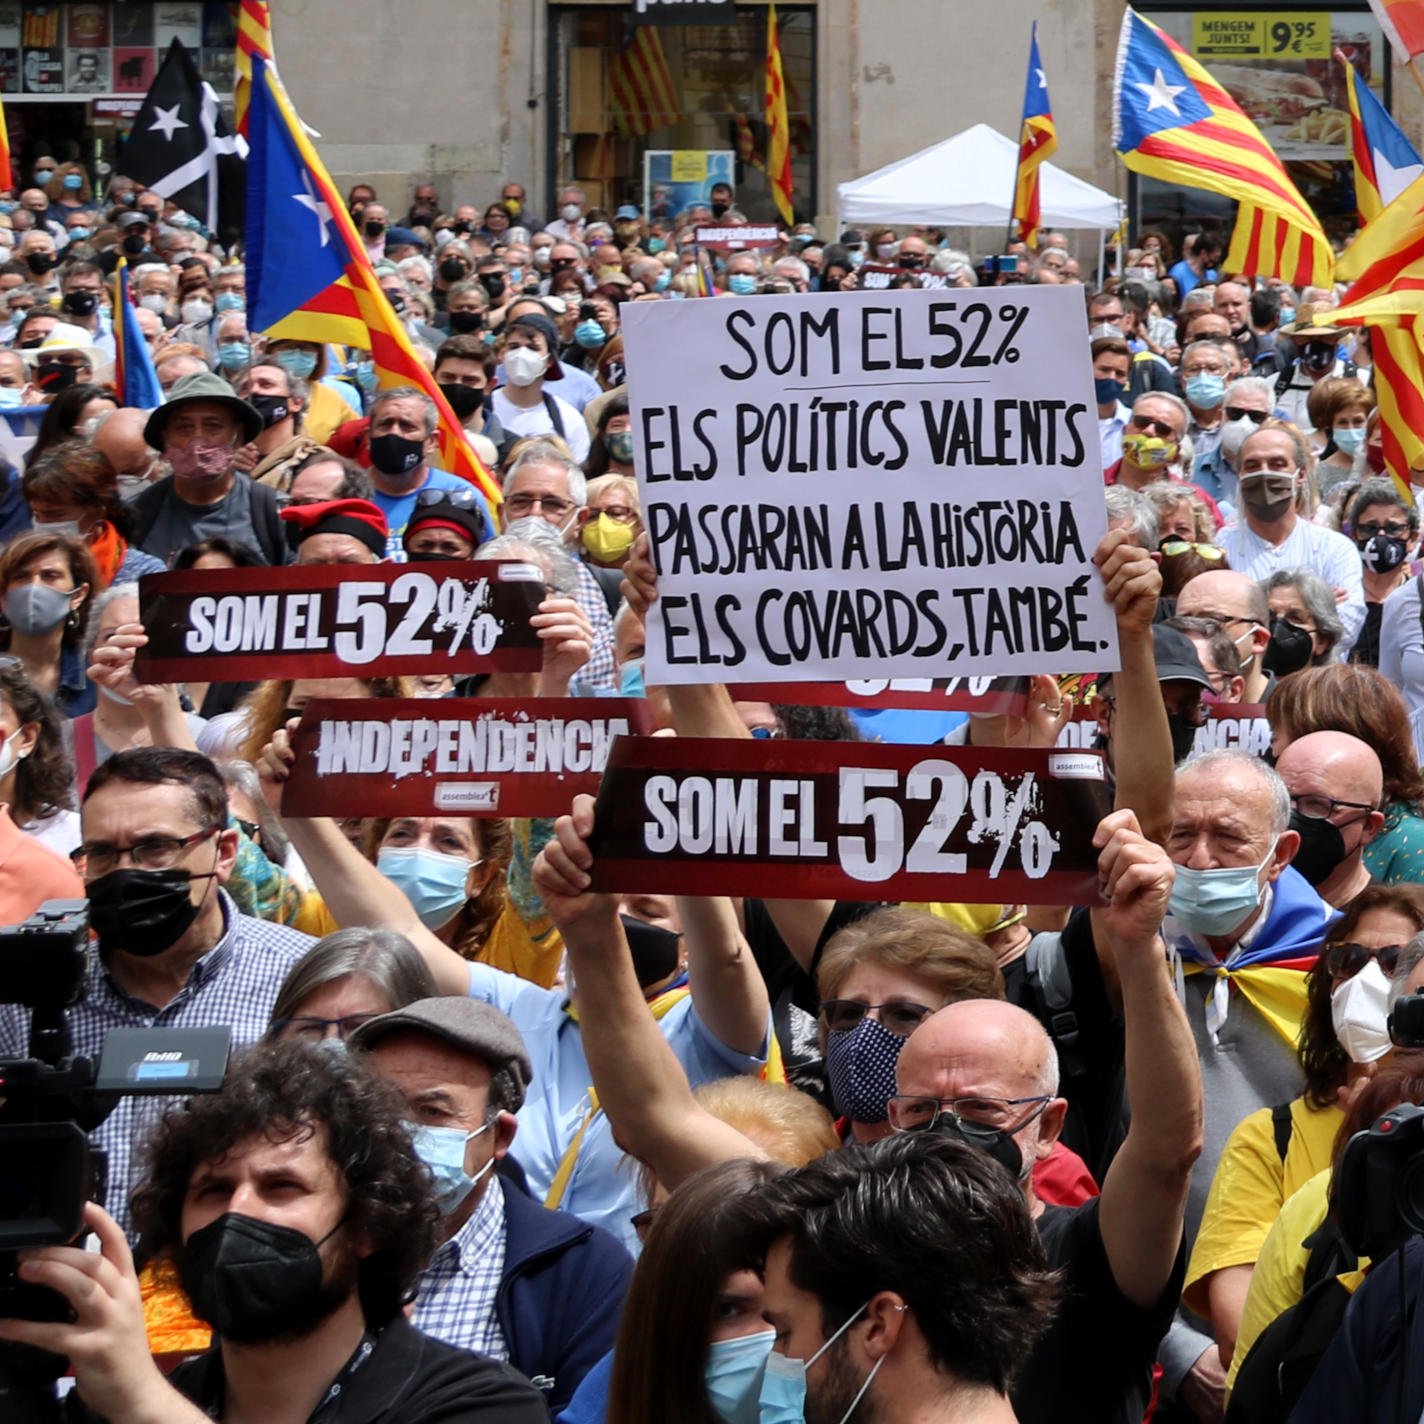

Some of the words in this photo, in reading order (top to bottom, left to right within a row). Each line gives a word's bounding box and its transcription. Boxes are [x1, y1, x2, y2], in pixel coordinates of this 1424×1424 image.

[1202, 21, 1255, 32] MENGEM
[1208, 33, 1250, 44] JUNTS!
[720, 307, 839, 380] SOM
[861, 307, 924, 371] EL
[929, 302, 1029, 368] 52%
[642, 405, 718, 482] ELS
[921, 399, 1087, 469] VALENTS
[648, 501, 832, 575] PASSARAN
[842, 503, 870, 570] A
[874, 501, 933, 571] LA
[186, 594, 279, 653] SOM
[282, 593, 329, 649] EL
[334, 572, 504, 665] 52%
[660, 592, 747, 666] ELS
[755, 587, 964, 666] COVARDS,
[953, 575, 1109, 655] TAMBÉ.
[644, 776, 758, 855] SOM
[769, 779, 828, 857] EL
[837, 759, 1061, 882] 52%
